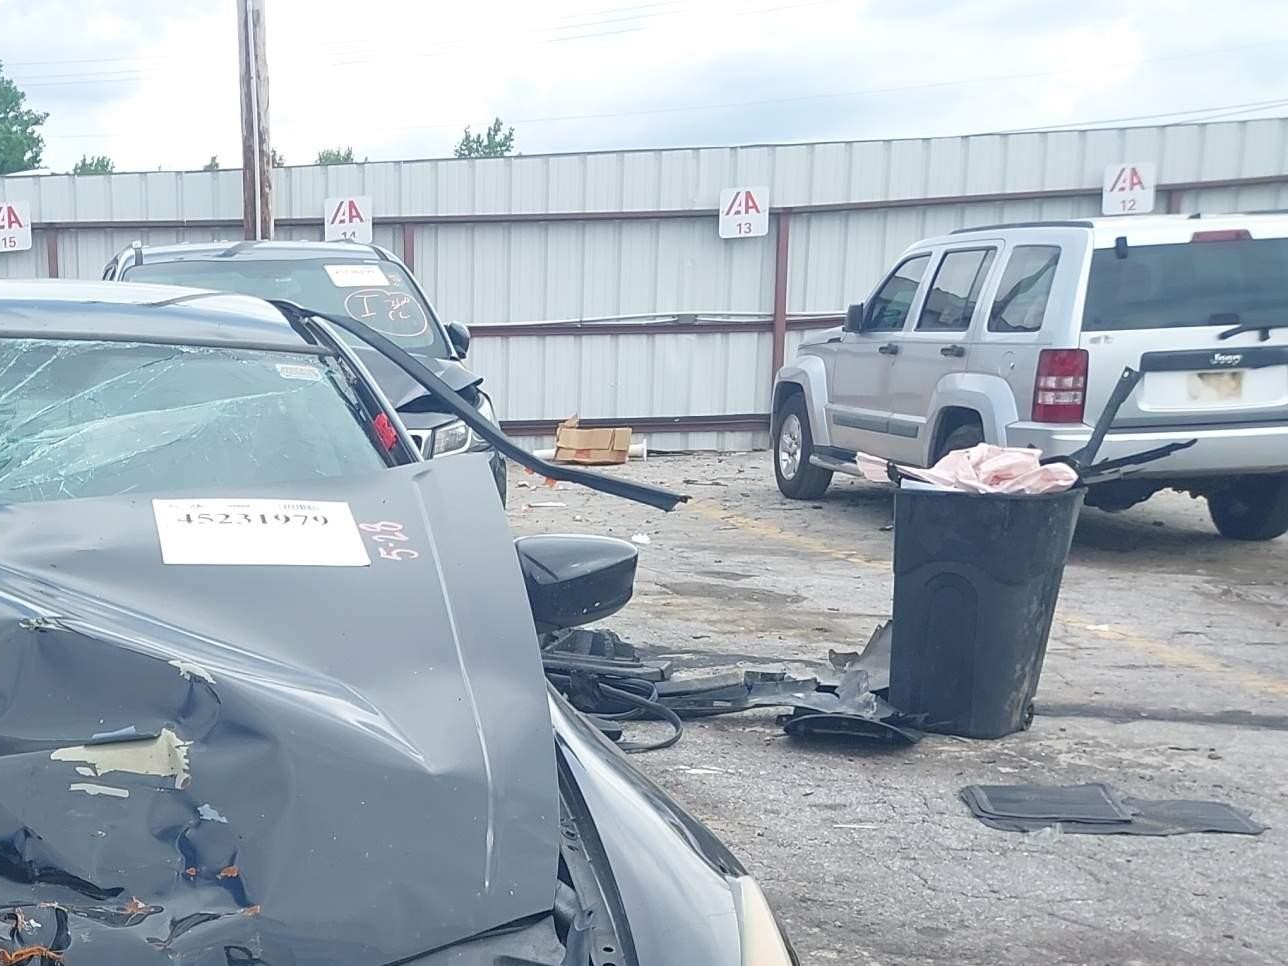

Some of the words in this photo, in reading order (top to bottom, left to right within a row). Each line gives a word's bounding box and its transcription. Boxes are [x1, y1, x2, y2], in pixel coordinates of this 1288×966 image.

[1120, 199, 1137, 212] 12
[736, 222, 752, 235] 13
[1, 235, 17, 248] 15
[177, 512, 330, 527] 45231979
